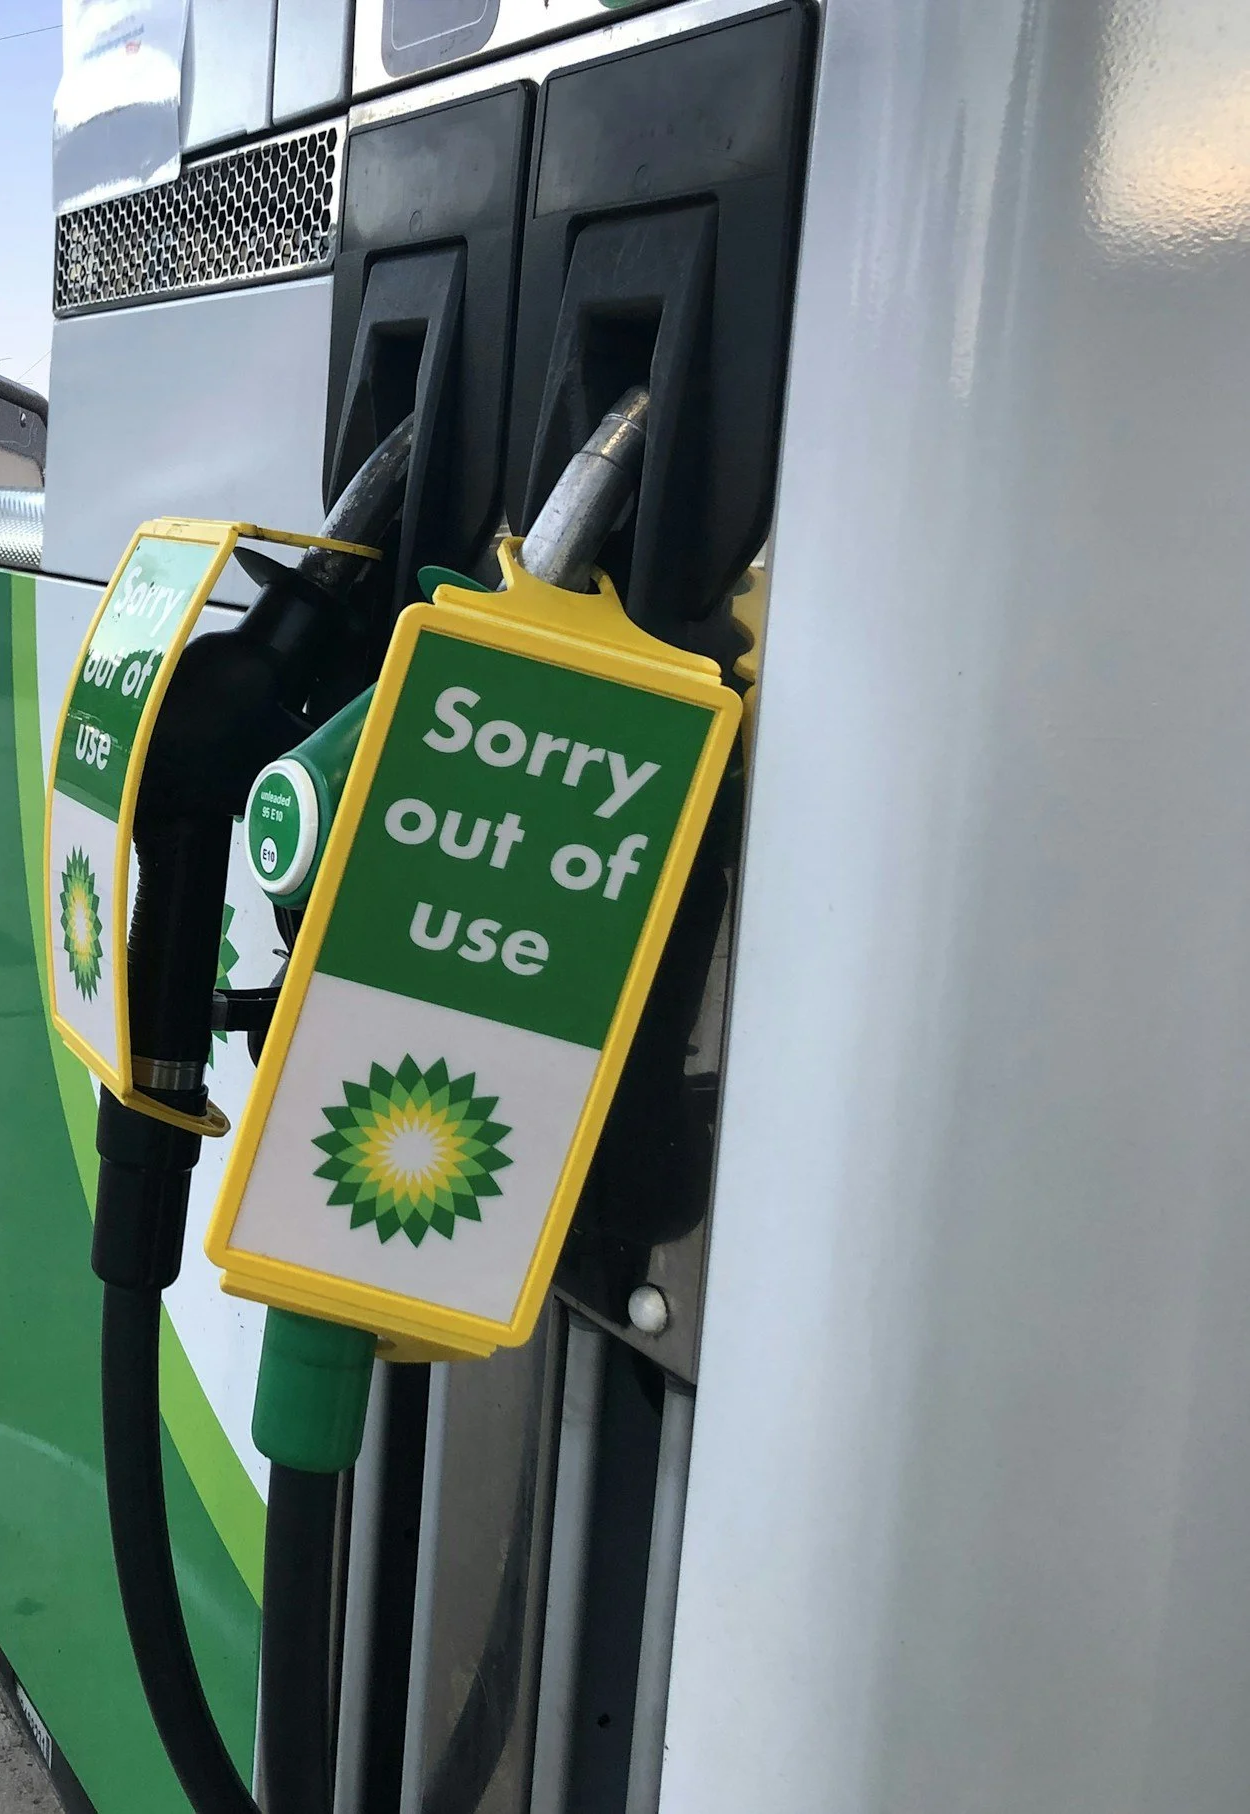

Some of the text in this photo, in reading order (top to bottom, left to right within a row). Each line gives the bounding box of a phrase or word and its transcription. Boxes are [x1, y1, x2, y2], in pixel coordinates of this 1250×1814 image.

[114, 566, 184, 637] Sorry
[83, 644, 163, 700] out of
[75, 721, 111, 771] use
[421, 685, 663, 819] Sorry
[261, 792, 291, 806] unleaded
[271, 809, 283, 821] E10
[263, 849, 274, 862] E10
[384, 797, 649, 901] out of
[408, 901, 550, 976] use
